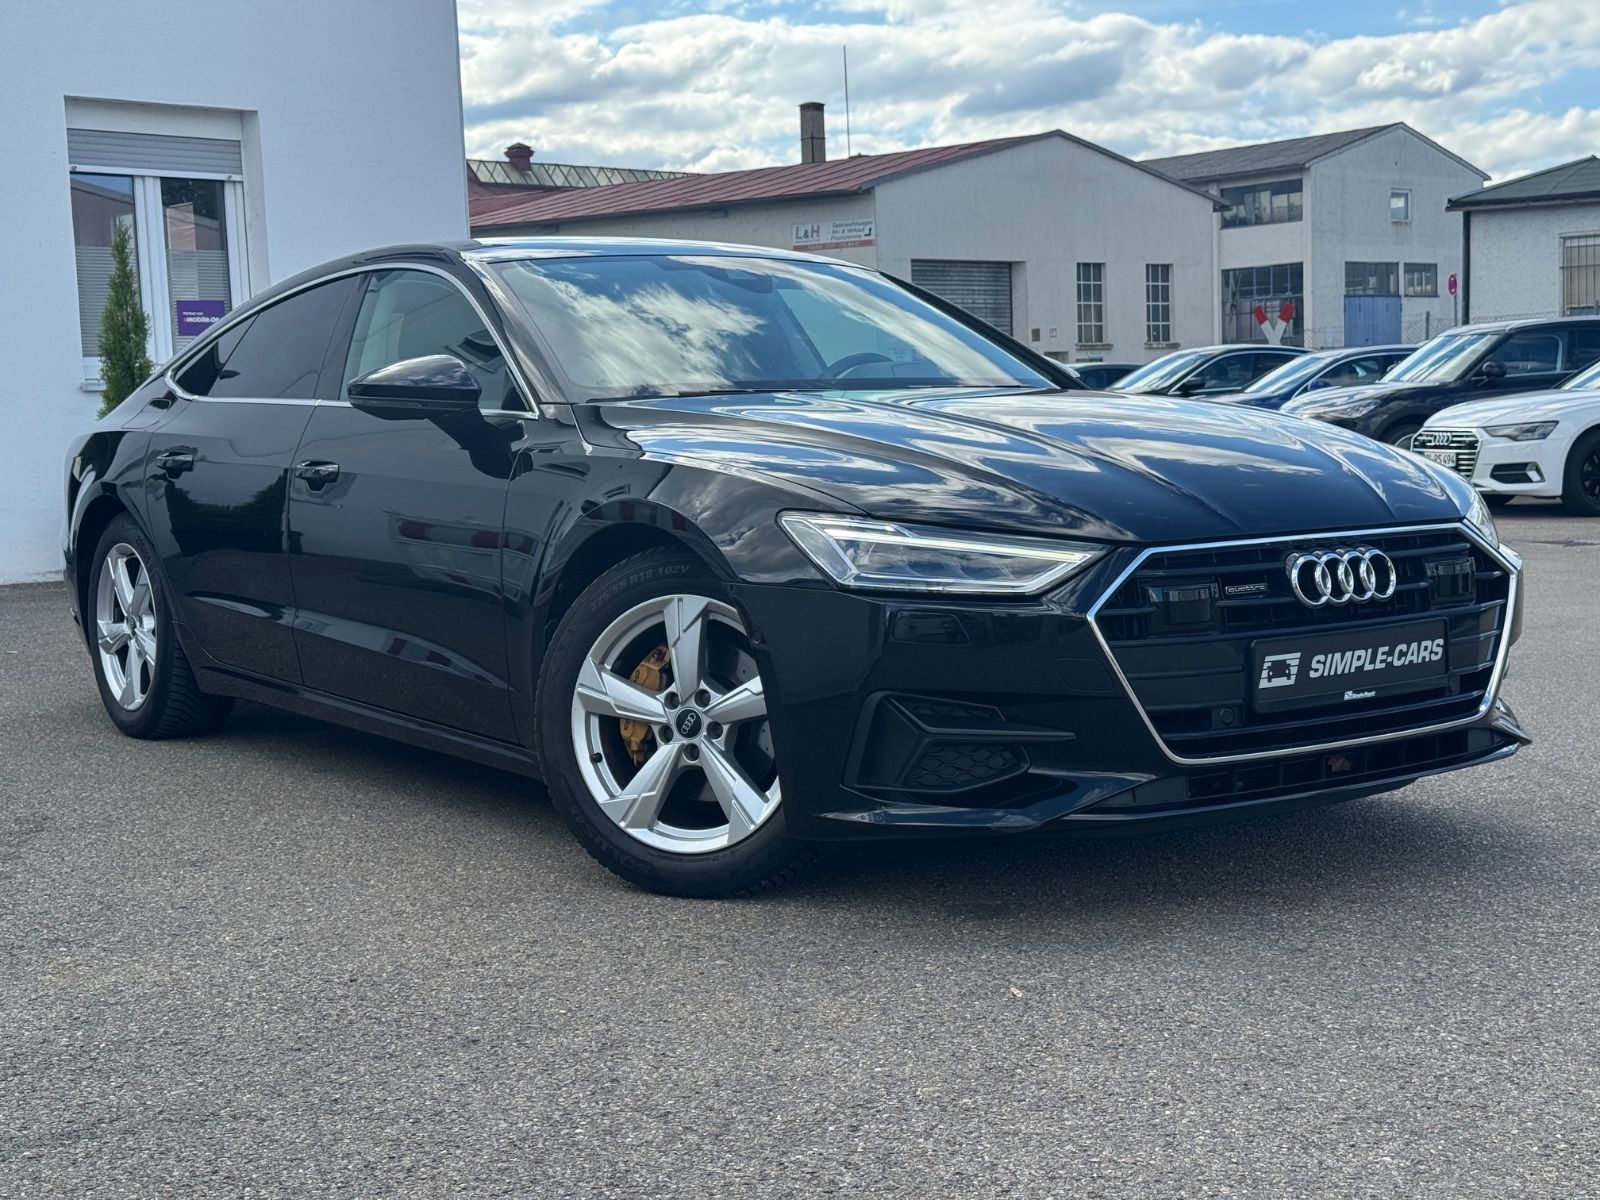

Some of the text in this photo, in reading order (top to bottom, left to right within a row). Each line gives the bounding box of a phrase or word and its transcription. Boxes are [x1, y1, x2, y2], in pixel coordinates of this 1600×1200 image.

[795, 225, 820, 240] L&H
[1443, 454, 1455, 464] 494
[629, 569, 653, 585] R18
[656, 564, 690, 576] 102V
[1227, 584, 1266, 594] quattro
[1308, 637, 1445, 679] SIMPLE-CARS
